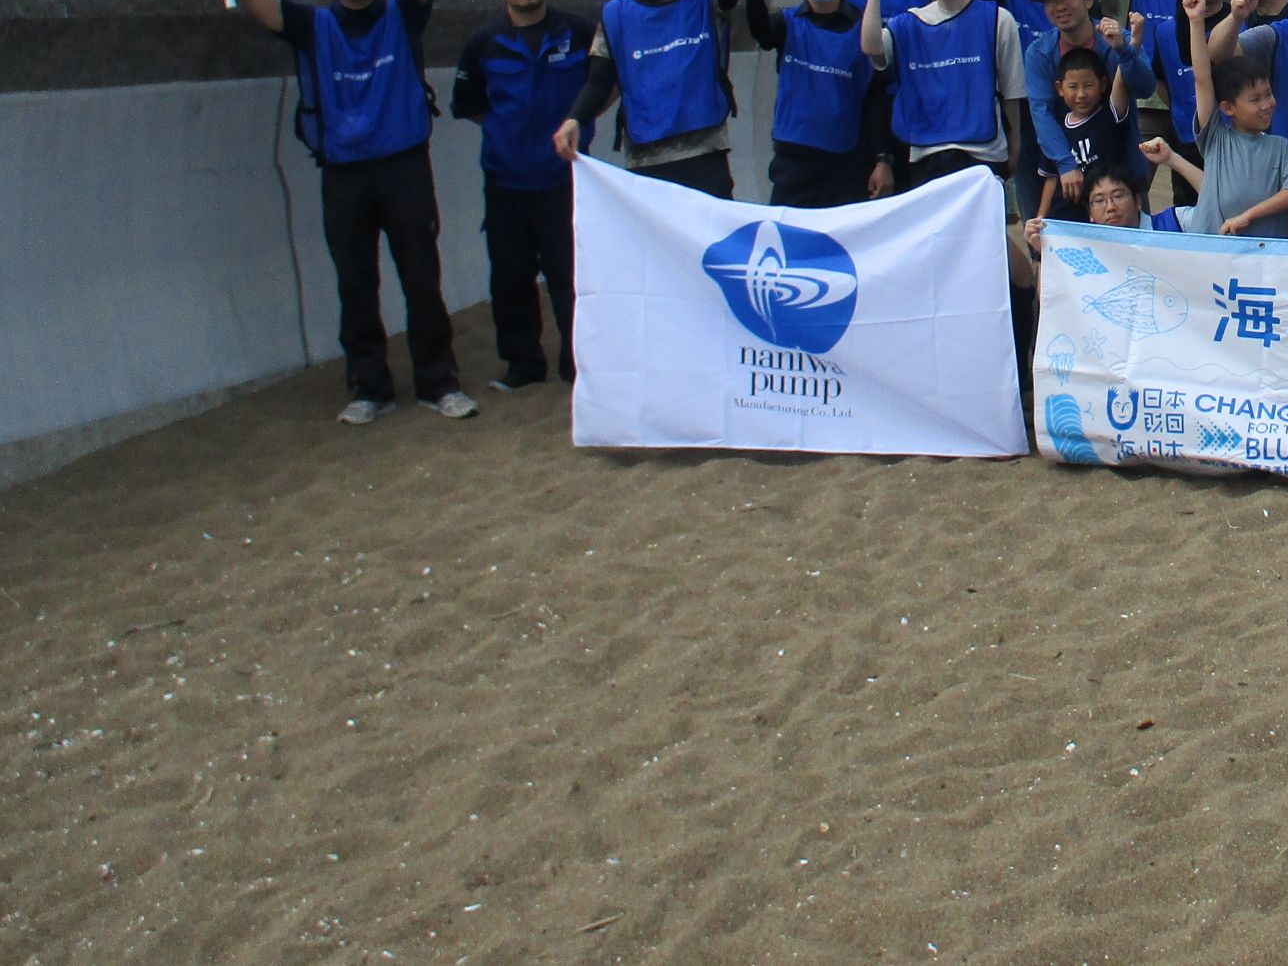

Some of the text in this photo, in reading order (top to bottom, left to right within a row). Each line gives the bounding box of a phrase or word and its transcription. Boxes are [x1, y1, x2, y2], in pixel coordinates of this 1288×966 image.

[740, 345, 846, 376] naniwa
[750, 370, 842, 405] pump
[734, 398, 809, 416] Manufacturing
[1143, 388, 1187, 410] 日本
[1247, 421, 1279, 434] FOR
